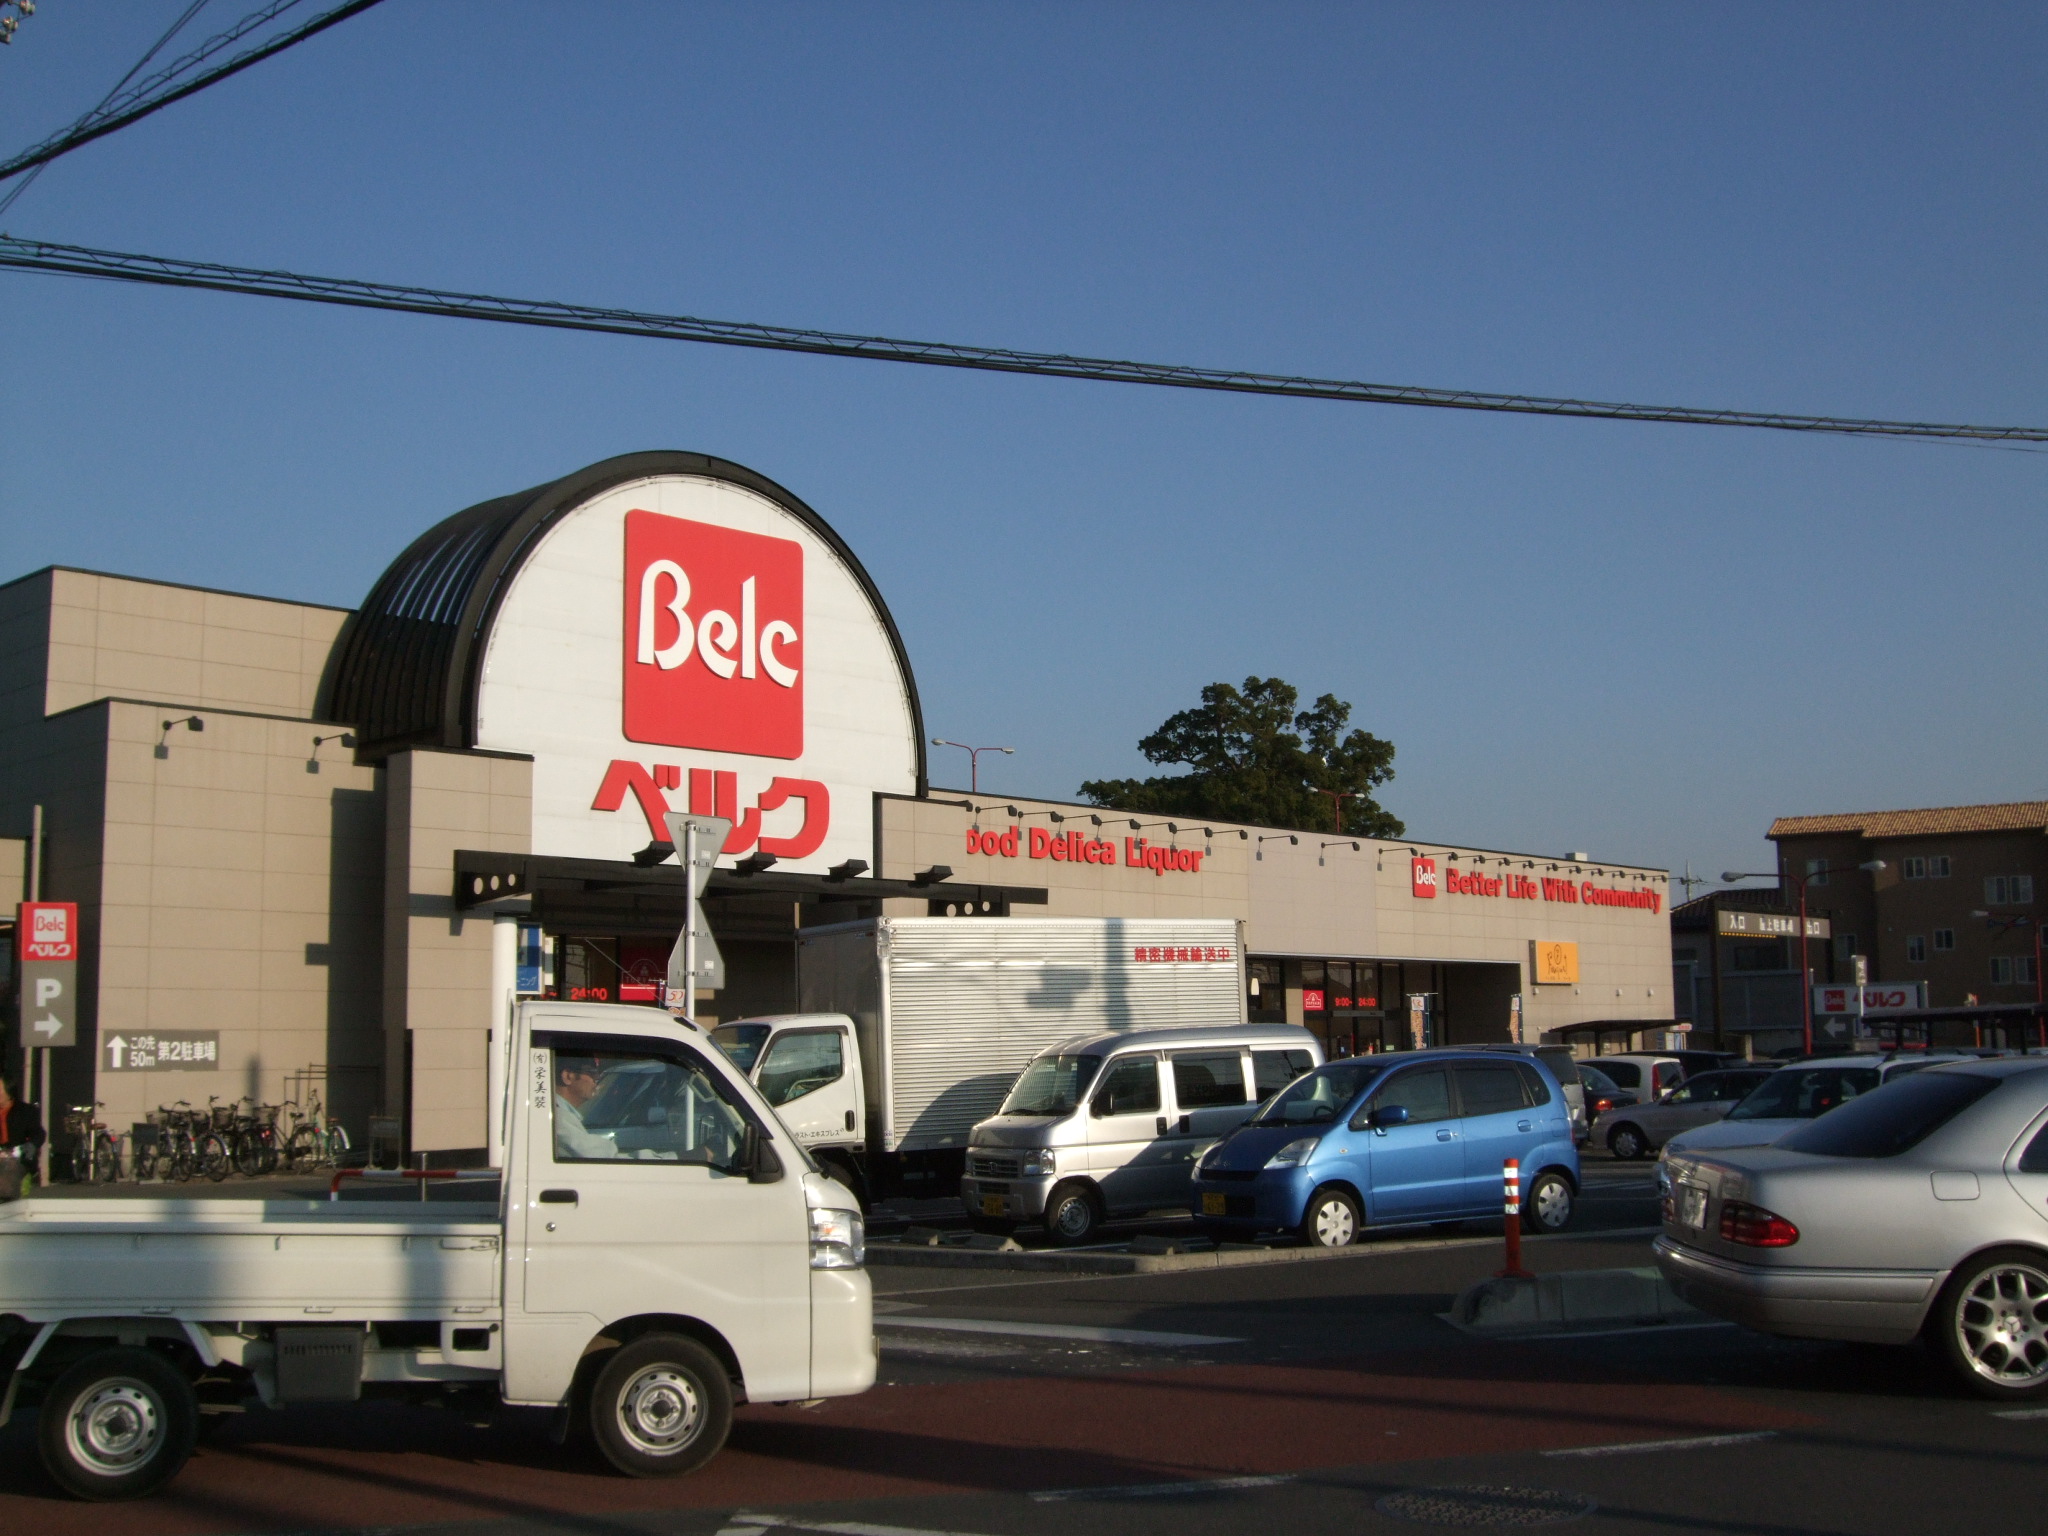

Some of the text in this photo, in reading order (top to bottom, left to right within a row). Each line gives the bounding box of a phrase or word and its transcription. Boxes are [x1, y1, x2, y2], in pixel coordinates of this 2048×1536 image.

[636, 558, 799, 688] Belc
[590, 759, 830, 859] ベルク
[966, 825, 1204, 876] ood Delica Liquor
[1416, 865, 1436, 886] Belc
[1446, 867, 1662, 914] Better Life With Community
[36, 916, 65, 931] Belc
[1730, 914, 1745, 930] 入口
[1806, 920, 1820, 935] 出口
[28, 944, 71, 956] ベルク
[36, 978, 62, 1006] P
[571, 988, 607, 1000] 24:00
[1358, 997, 1376, 1007] 24:00
[130, 1035, 156, 1050] この先
[158, 1041, 216, 1061] 第2駐車場
[130, 1051, 155, 1067] 50m
